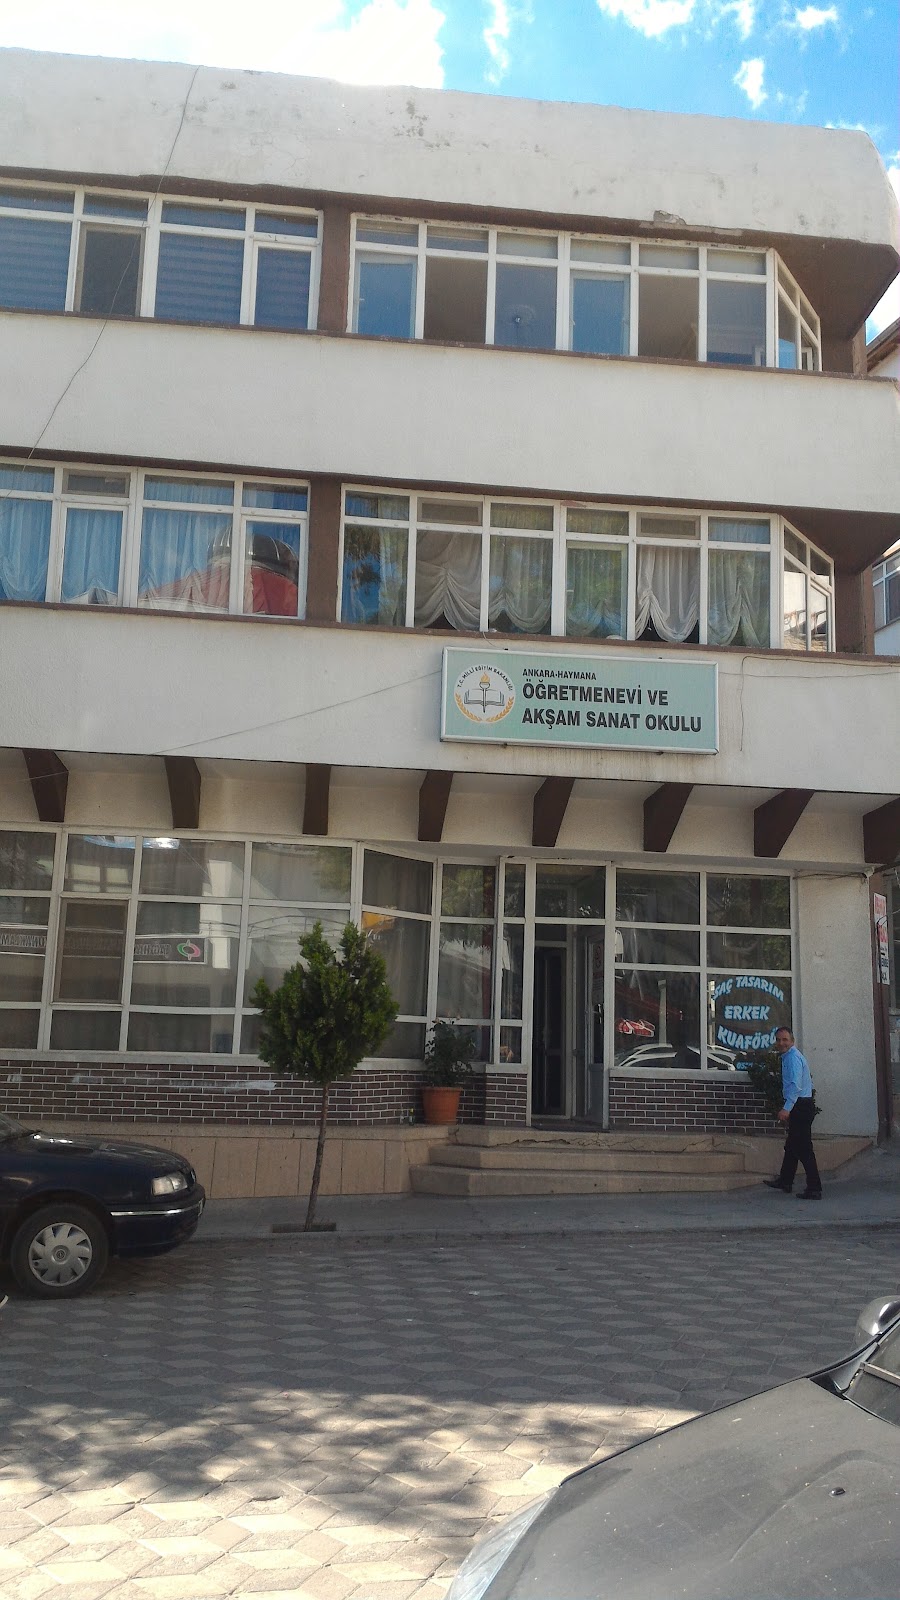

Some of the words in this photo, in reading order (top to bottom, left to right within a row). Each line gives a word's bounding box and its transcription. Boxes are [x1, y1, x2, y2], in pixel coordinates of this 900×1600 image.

[522, 668, 597, 681] ANKARA-HAYMANA
[522, 679, 642, 705] ÖĞRETMENEVİ
[647, 690, 668, 706] VE
[521, 708, 581, 730] AKŞAM
[586, 711, 640, 729] SANAT
[645, 714, 702, 732] OKULU
[713, 979, 733, 1000] SAÇ
[736, 976, 784, 1002] TASARIM
[724, 1005, 770, 1020] ERKEK
